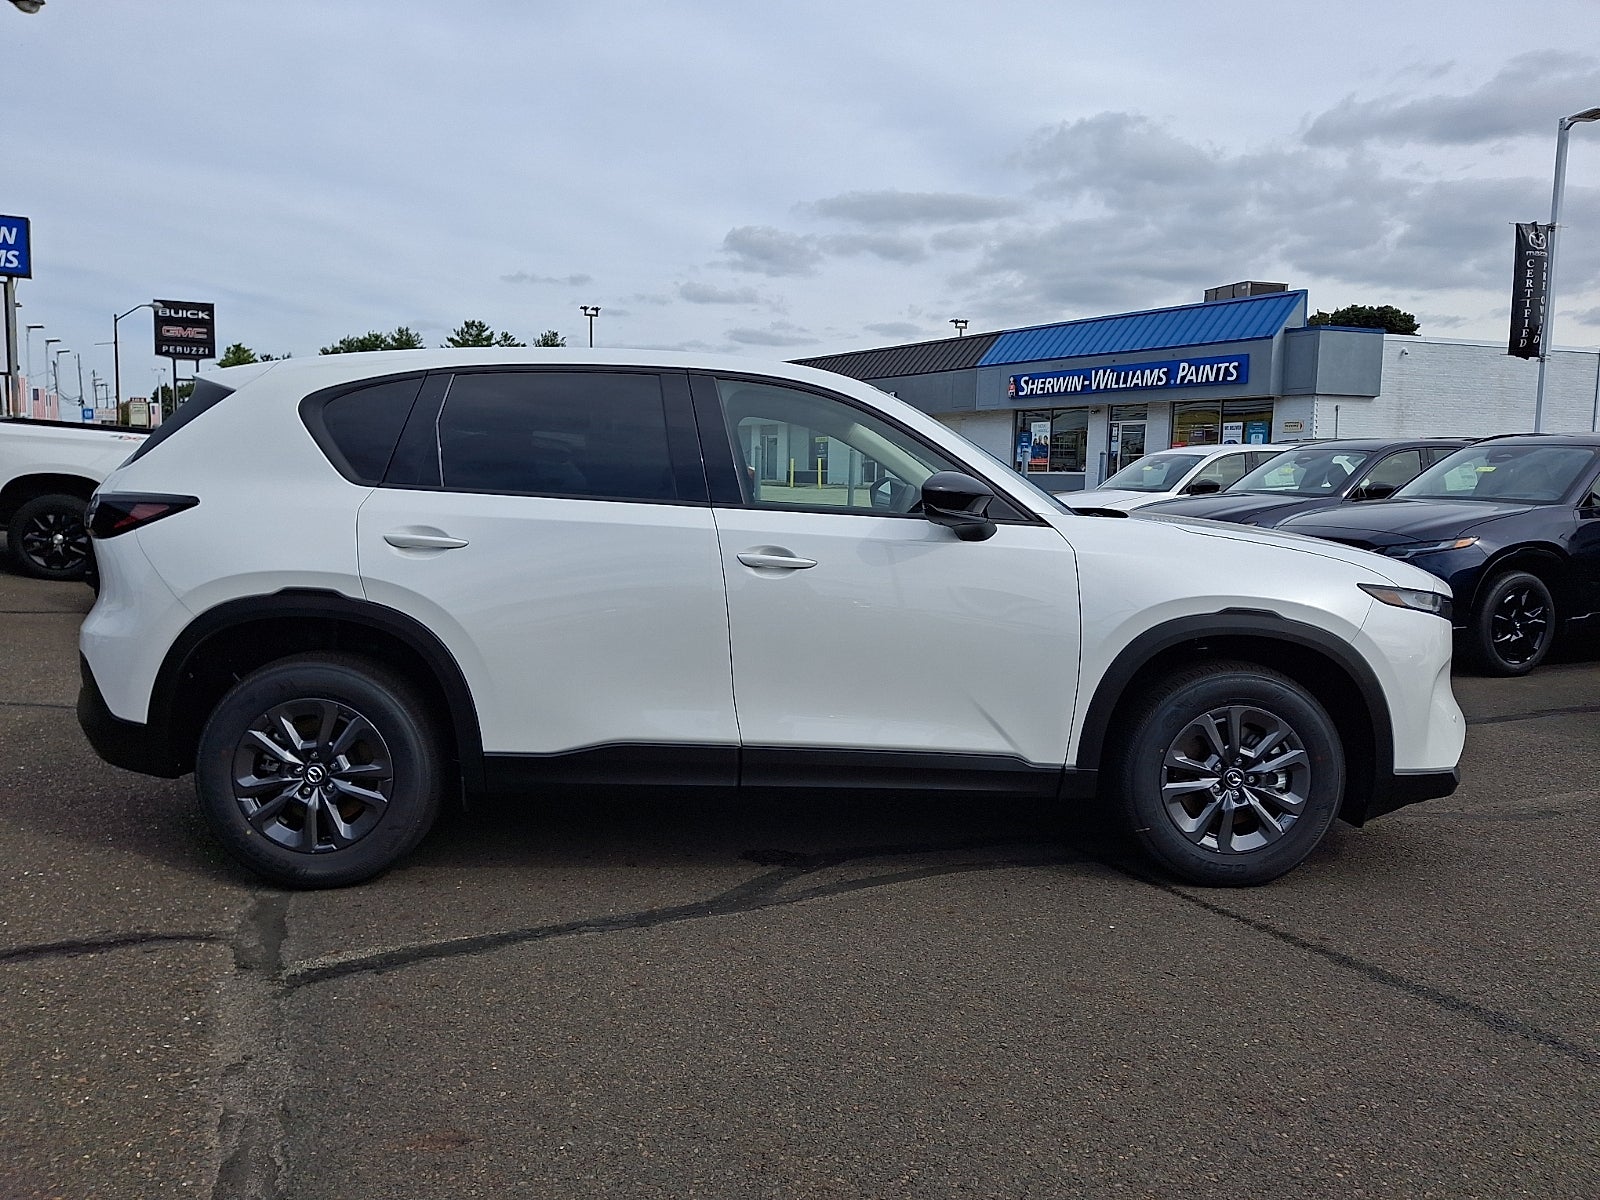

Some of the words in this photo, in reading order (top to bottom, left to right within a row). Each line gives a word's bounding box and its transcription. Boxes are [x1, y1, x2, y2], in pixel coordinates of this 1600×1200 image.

[1519, 259, 1535, 348] CERTIFIED
[158, 308, 210, 320] BUICK
[162, 326, 208, 339] GMC
[162, 345, 209, 355] PERUZZI
[1018, 367, 1169, 396] SHERWIN-WILLIAMS
[1176, 361, 1239, 385] PAINTS
